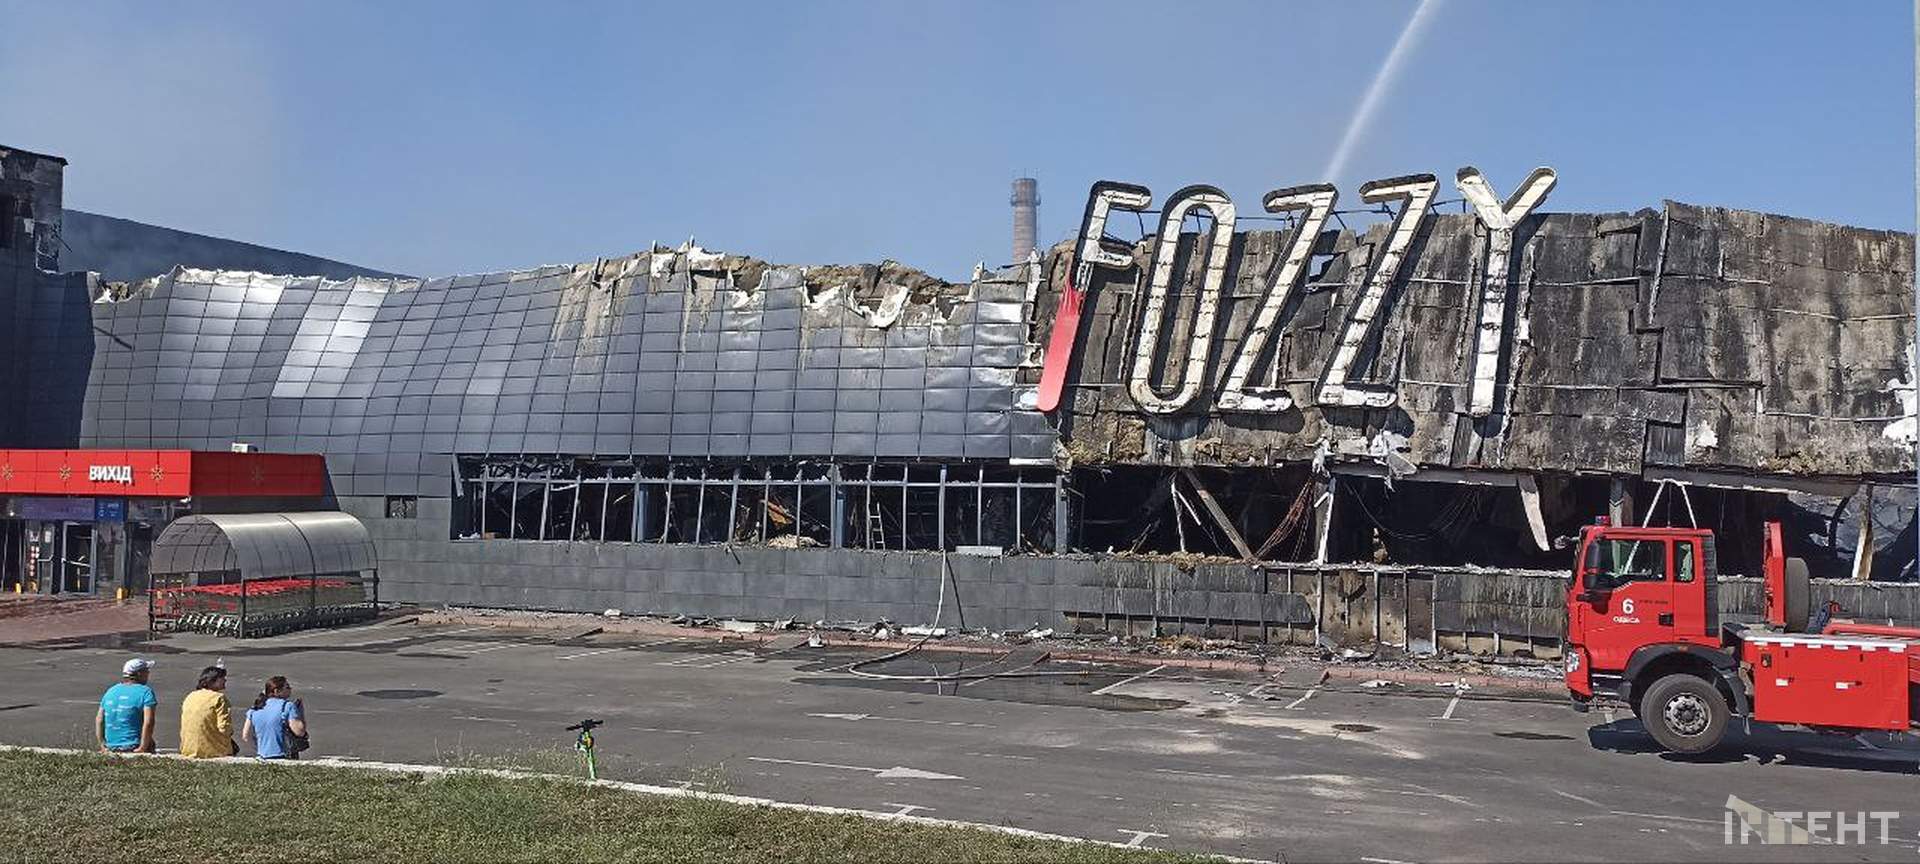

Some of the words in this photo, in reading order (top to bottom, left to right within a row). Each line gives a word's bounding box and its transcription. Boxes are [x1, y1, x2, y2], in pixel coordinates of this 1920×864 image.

[1036, 166, 1557, 416] FOZZY
[89, 465, 132, 485] ВИХІД
[1622, 598, 1634, 614] 6
